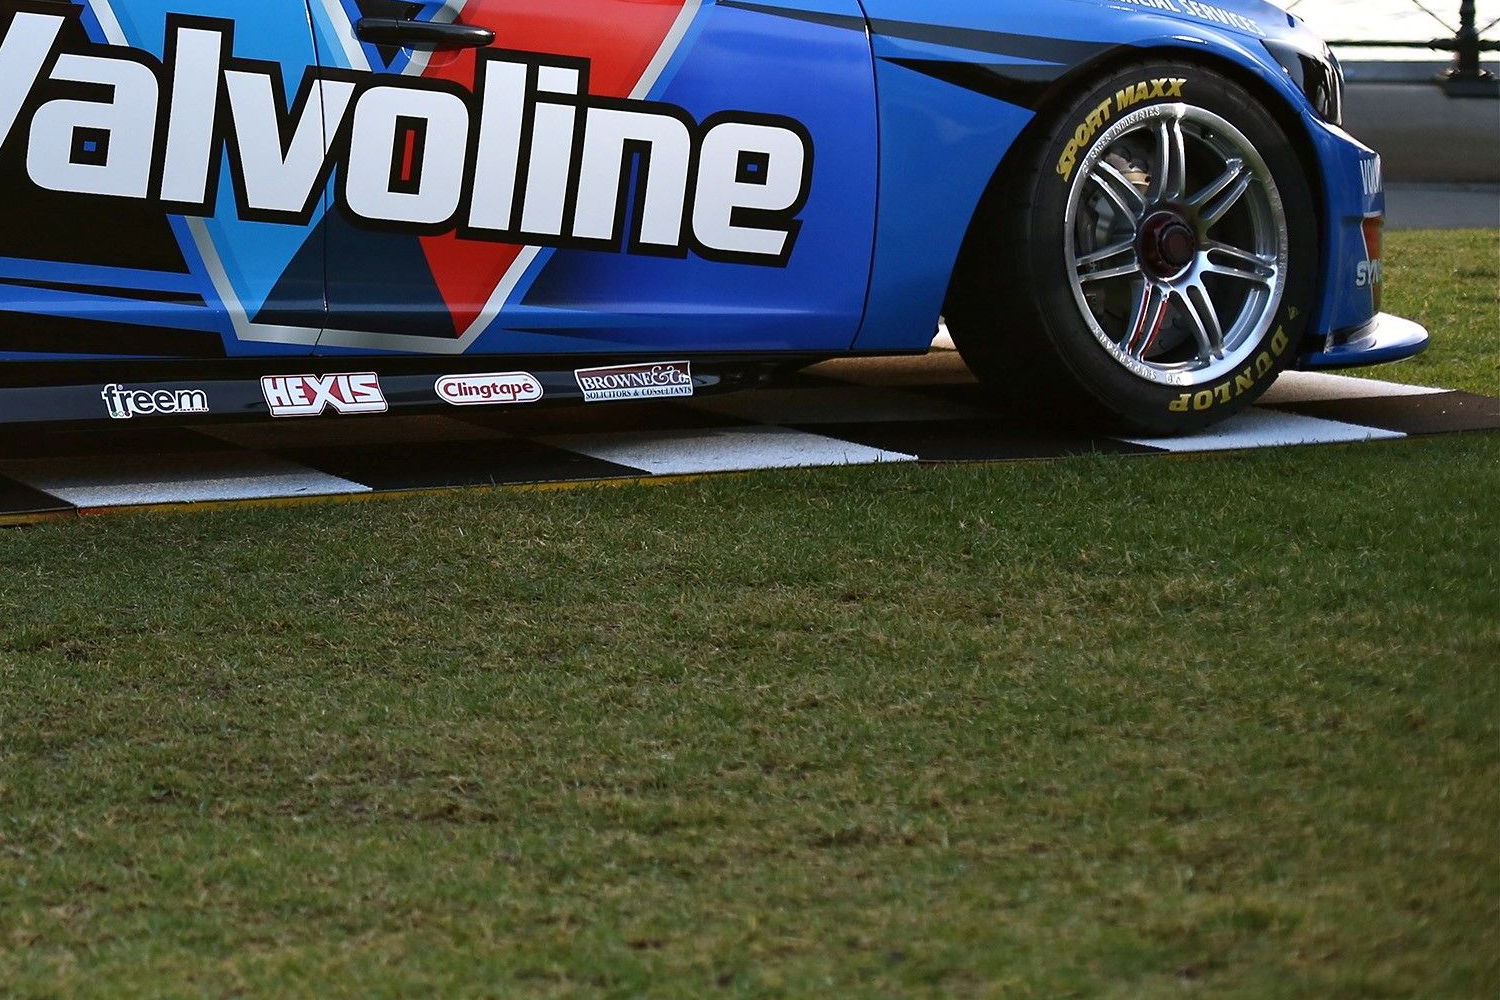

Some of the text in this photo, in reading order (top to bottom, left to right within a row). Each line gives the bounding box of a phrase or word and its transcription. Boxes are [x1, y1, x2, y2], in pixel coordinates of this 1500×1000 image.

[1056, 77, 1188, 183] SPORT MAXX
[1168, 324, 1289, 412] DUNLOP
[102, 384, 208, 417] freem
[262, 374, 387, 415] HEXIS
[442, 381, 534, 401] Clingtape
[585, 390, 632, 400] SOLICITORS
[641, 386, 692, 396] CONSULTANTS
